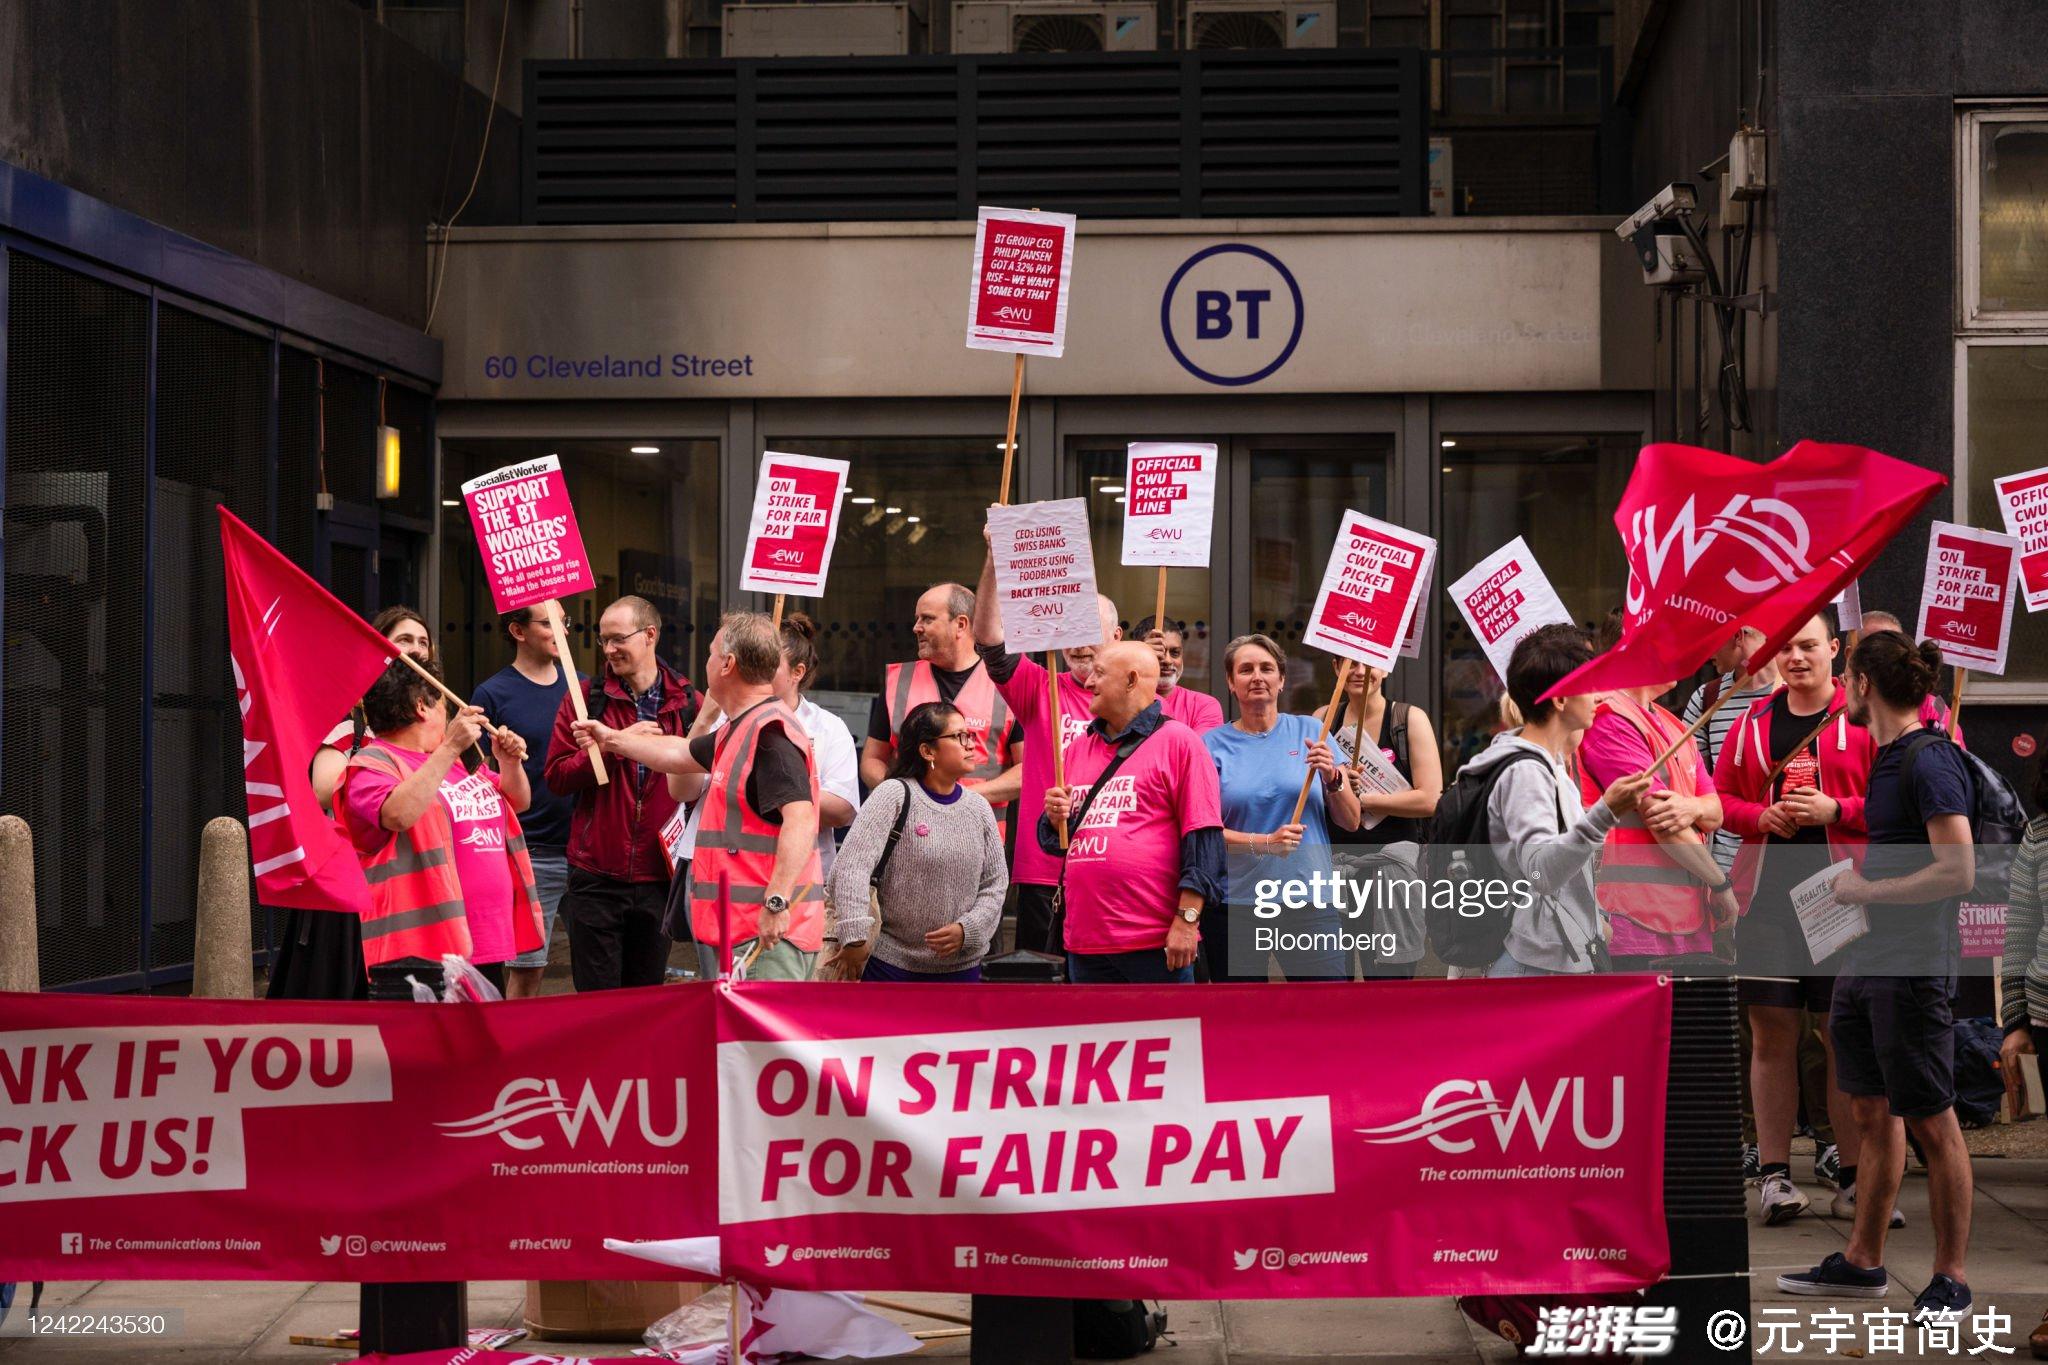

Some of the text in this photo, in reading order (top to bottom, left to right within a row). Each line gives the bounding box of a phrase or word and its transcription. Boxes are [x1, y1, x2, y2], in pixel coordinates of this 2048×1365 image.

[995, 234, 1053, 248] BT GROUP CEO
[993, 247, 1052, 262] PHILIP JANSEN
[990, 259, 1008, 270] GOT
[1015, 261, 1034, 273] 32%
[1035, 264, 1053, 275] PAY
[986, 272, 1004, 283] RISE
[1011, 274, 1025, 286] WE
[1026, 276, 1056, 288] WANT
[986, 285, 1051, 300] SOME OF THAT
[1000, 306, 1032, 320] CWU
[1196, 290, 1271, 340] BT
[485, 354, 753, 379] 60 Cleveland Street
[1136, 458, 1196, 472] OFFICIAL
[770, 480, 790, 492] ON
[1136, 472, 1167, 486] CWU
[474, 477, 551, 513] SUPPORT
[1135, 486, 1183, 500] PICKET
[2010, 485, 2048, 507] OFFIC
[768, 495, 811, 508] STRIKE
[1135, 501, 1167, 514] LINE
[478, 501, 539, 534] THE BT
[766, 510, 821, 524] FOR FAIR
[2014, 503, 2048, 522] CWU
[764, 524, 790, 536] PAY
[1015, 526, 1061, 540] CEOs USING
[1151, 528, 1182, 540] CWU
[2020, 519, 2048, 538] PIC
[1014, 538, 1066, 552] SWISS BANKS
[1350, 538, 1407, 564] OFFICIAL
[2024, 536, 2048, 553] LIN
[492, 539, 562, 575] STRIKES
[775, 549, 804, 563] CWU
[1010, 554, 1074, 570] WORKERS USING
[1346, 553, 1378, 570] CWU
[1940, 551, 1959, 564] ON
[526, 567, 544, 580] need
[552, 564, 564, 574] pay
[566, 560, 580, 569] rise
[1019, 568, 1068, 582] FOODBANKS
[1342, 566, 1389, 588] PICKET
[1938, 565, 1981, 582] STRIKE
[506, 585, 525, 597] Make
[526, 581, 540, 592] the
[567, 572, 580, 583] pay
[1010, 584, 1082, 599] BACK THE STRIKE
[1338, 580, 1370, 598] LINE
[1469, 564, 1517, 607] OFFICIAL
[1936, 580, 1994, 598] FOR FAIR
[1476, 591, 1500, 618] CWU
[1935, 594, 1960, 607] PAY
[1032, 602, 1064, 617] CWU
[1482, 593, 1520, 629] PICKET
[1346, 612, 1377, 631] CWU
[1489, 613, 1515, 640] LINE
[1948, 620, 1977, 636] CWU
[1336, 735, 1379, 776] L'ÉGLITÉ
[1100, 796, 1132, 809] FAIR
[1084, 812, 1115, 826] RISE
[1958, 907, 2009, 926] STRIKE
[113, 1039, 180, 1099] IF
[203, 1036, 353, 1093] YOU
[755, 1037, 1171, 1118] ON STRIKE
[494, 1077, 688, 1151] CWU
[1421, 1076, 1625, 1154] CWU
[98, 1116, 215, 1180] US!
[761, 1114, 1304, 1202] FOR FAIR PAY
[492, 1160, 690, 1176] The communications union
[1420, 1164, 1625, 1182] The communications union
[88, 1238, 261, 1251] The Communications Union
[370, 1240, 447, 1254] @CWUNews
[509, 1238, 572, 1250] #TheCWU
[791, 1246, 891, 1262] @DaveWardGS
[984, 1252, 1168, 1270] The Communications Union
[1288, 1250, 1369, 1267] @CWUNews
[1432, 1249, 1498, 1262] #TheCWU
[1563, 1248, 1627, 1261] CWU.ORG
